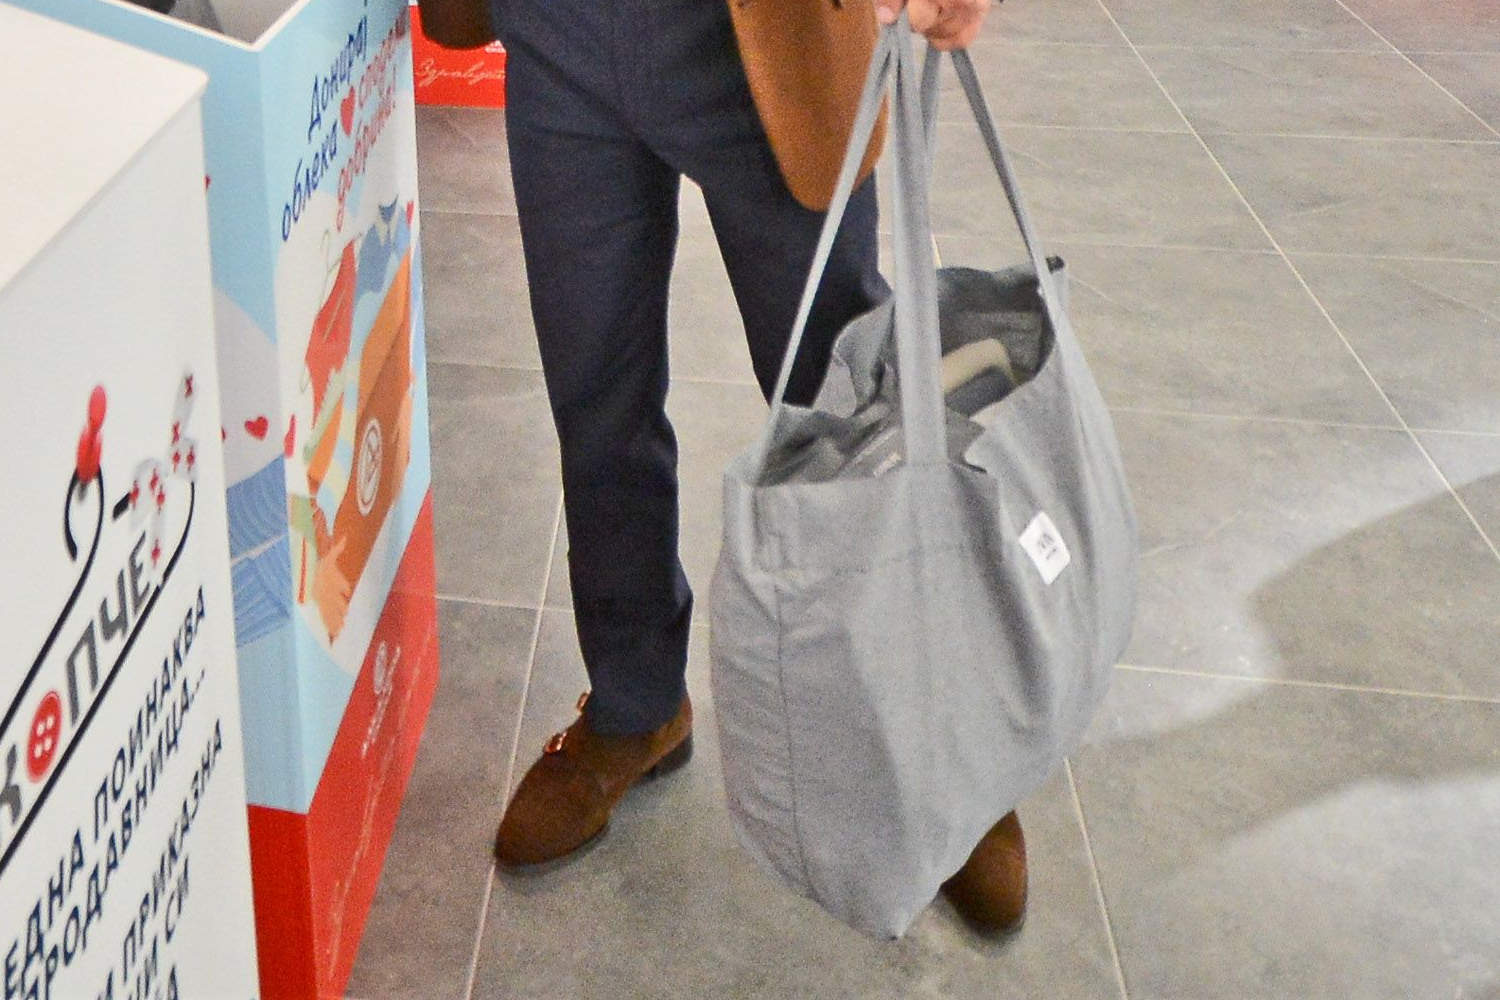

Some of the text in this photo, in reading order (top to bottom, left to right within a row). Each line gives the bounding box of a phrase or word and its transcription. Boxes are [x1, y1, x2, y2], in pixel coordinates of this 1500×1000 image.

[308, 0, 368, 143] Донирај
[282, 122, 338, 242] облека
[94, 585, 206, 840] ПОИНАКВА
[123, 718, 223, 984] ПРИКАЗНА
[165, 853, 190, 944] СИ
